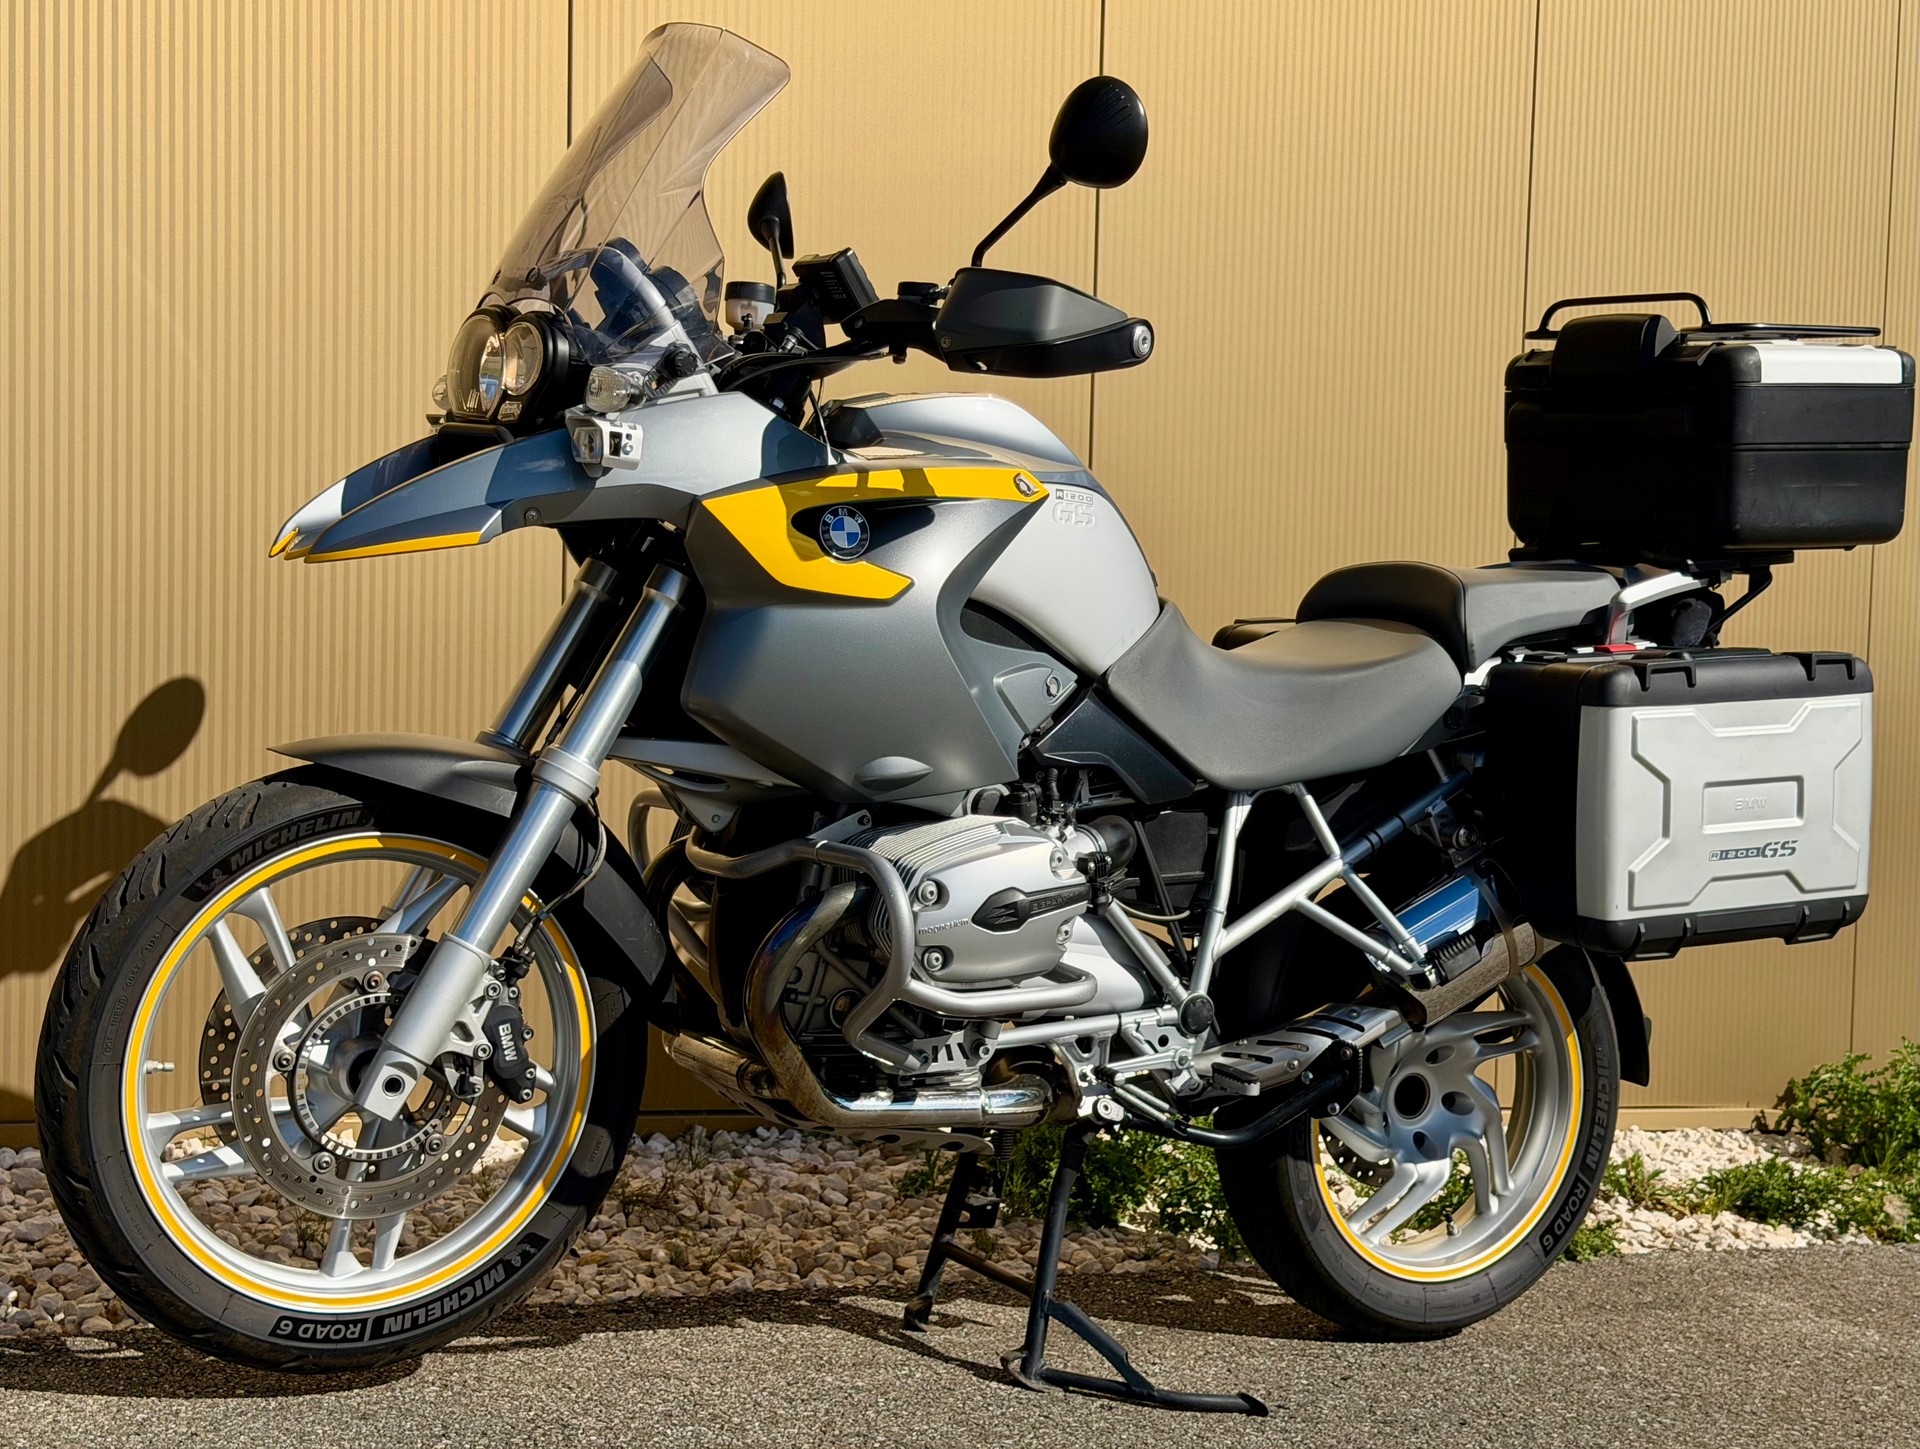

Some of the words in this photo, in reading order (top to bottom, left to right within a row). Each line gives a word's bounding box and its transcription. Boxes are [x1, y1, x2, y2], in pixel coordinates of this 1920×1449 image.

[1056, 489, 1093, 505] R1200
[824, 508, 864, 524] BMW
[1053, 501, 1095, 527] GS
[1735, 796, 1767, 811] BMW
[230, 811, 362, 872] MICHELIN
[498, 1023, 518, 1061] BMW
[1584, 1048, 1611, 1171] MICHELIN
[1554, 1183, 1587, 1236] ROAD
[1542, 1234, 1555, 1249] 6
[383, 1264, 506, 1335] MICHELIN
[276, 1319, 294, 1335] 6
[298, 1322, 362, 1341] ROAD
